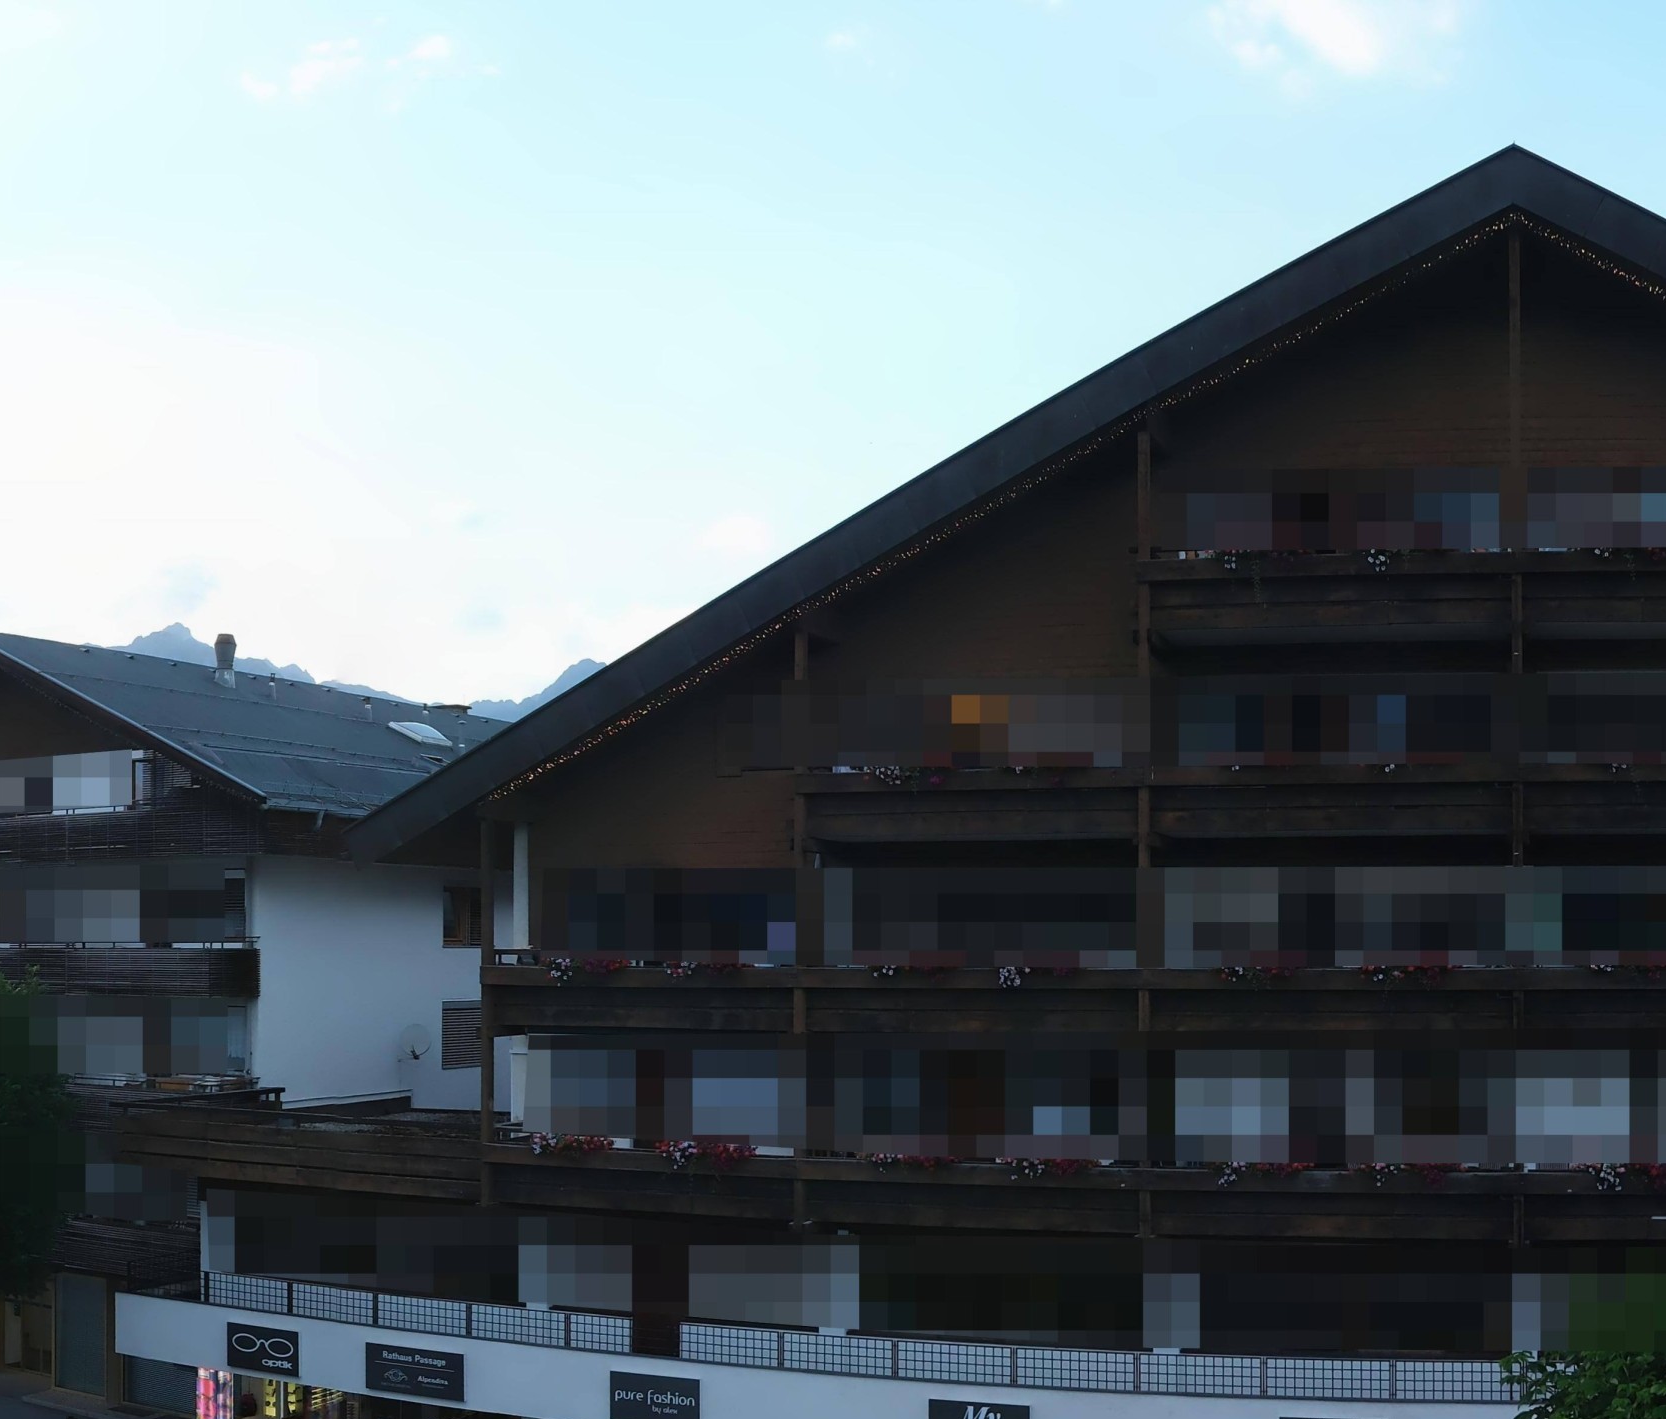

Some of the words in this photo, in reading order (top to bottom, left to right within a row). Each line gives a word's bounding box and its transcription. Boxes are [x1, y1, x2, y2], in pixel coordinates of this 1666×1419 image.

[261, 1357, 293, 1370] optik
[383, 1350, 412, 1362] Rathaus
[414, 1354, 446, 1367] Passage
[614, 1389, 644, 1401] pure
[647, 1389, 695, 1406] fashion
[652, 1405, 662, 1414] by
